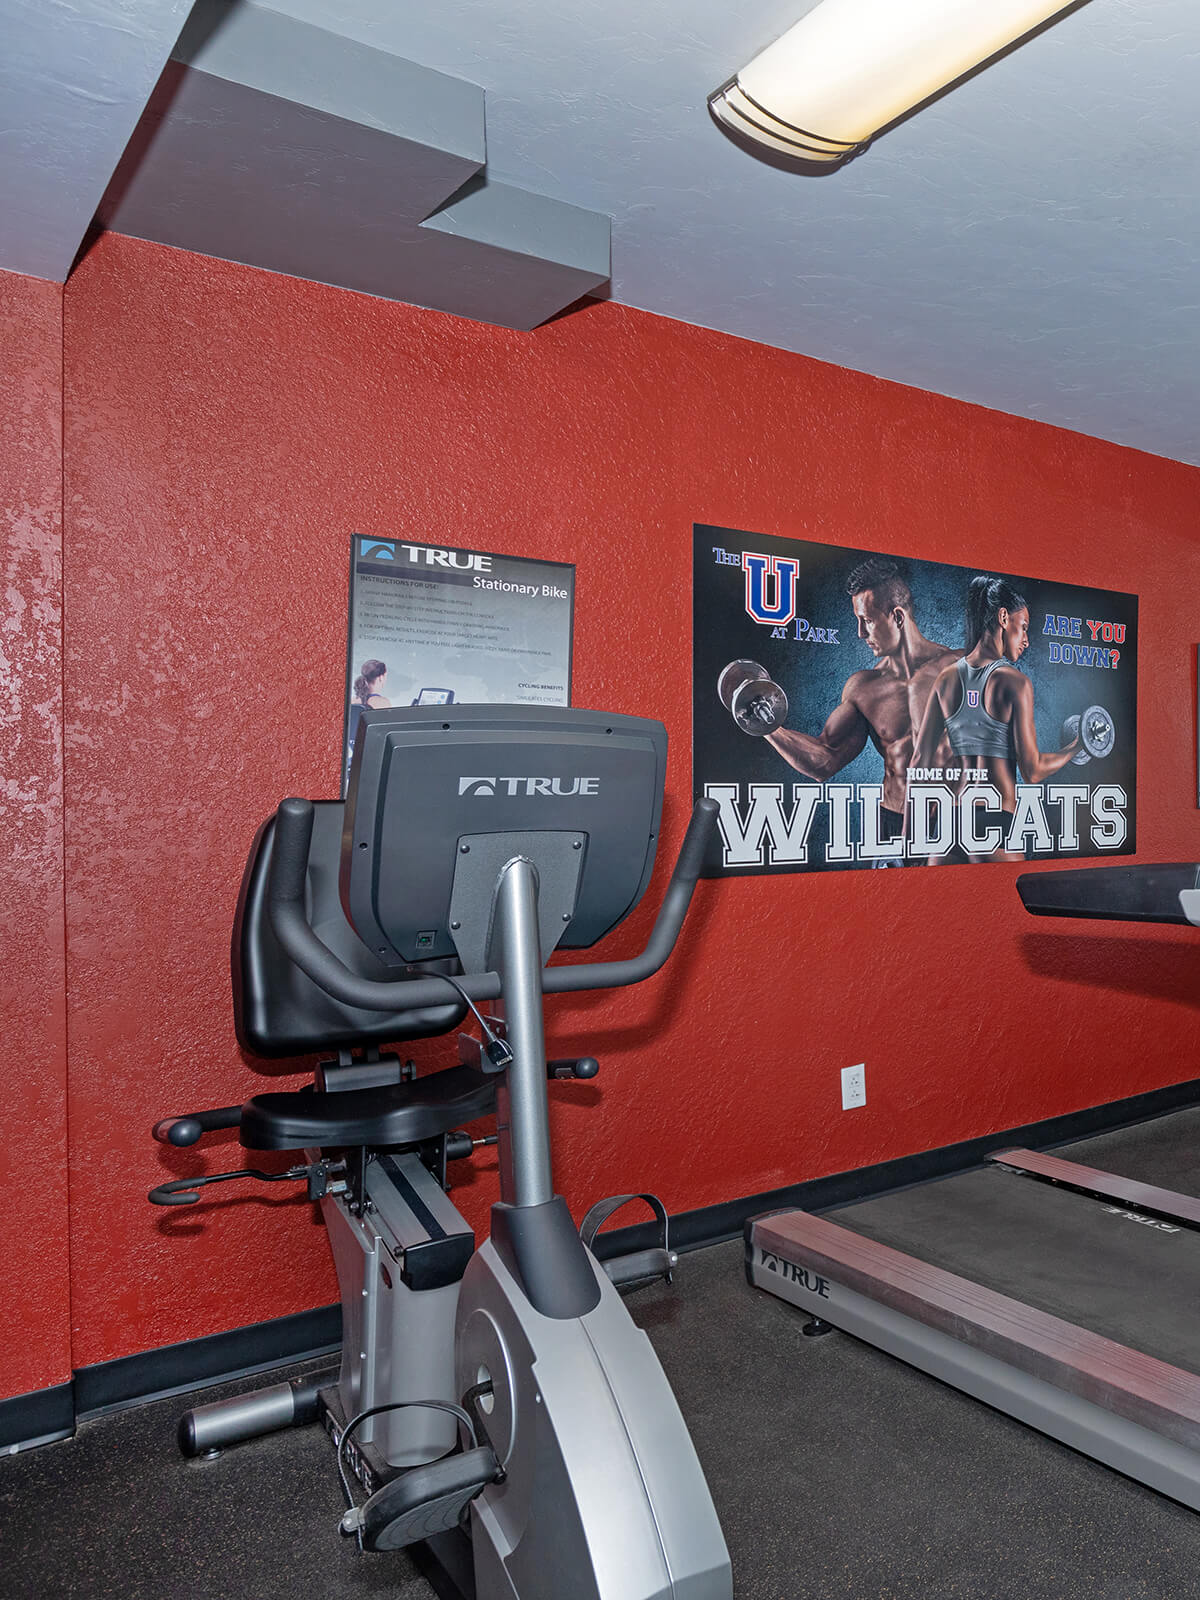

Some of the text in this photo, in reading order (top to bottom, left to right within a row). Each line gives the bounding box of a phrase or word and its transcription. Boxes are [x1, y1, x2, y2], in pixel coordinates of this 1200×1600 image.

[401, 544, 493, 573] TRUE
[360, 575, 409, 587] INSTRUCTIONS
[410, 580, 424, 588] FOR
[472, 576, 540, 599] Stationary
[542, 585, 568, 599] Bike
[741, 549, 801, 626] U
[1042, 613, 1127, 644] ARE YOU
[1048, 642, 1120, 669] DOWN?
[518, 682, 540, 690] CYCLING
[966, 688, 980, 708] U
[499, 776, 601, 797] TRUE
[906, 767, 988, 782] HOME OF THE
[704, 782, 1128, 868] WILDCATS
[776, 1258, 831, 1300] TRUE
